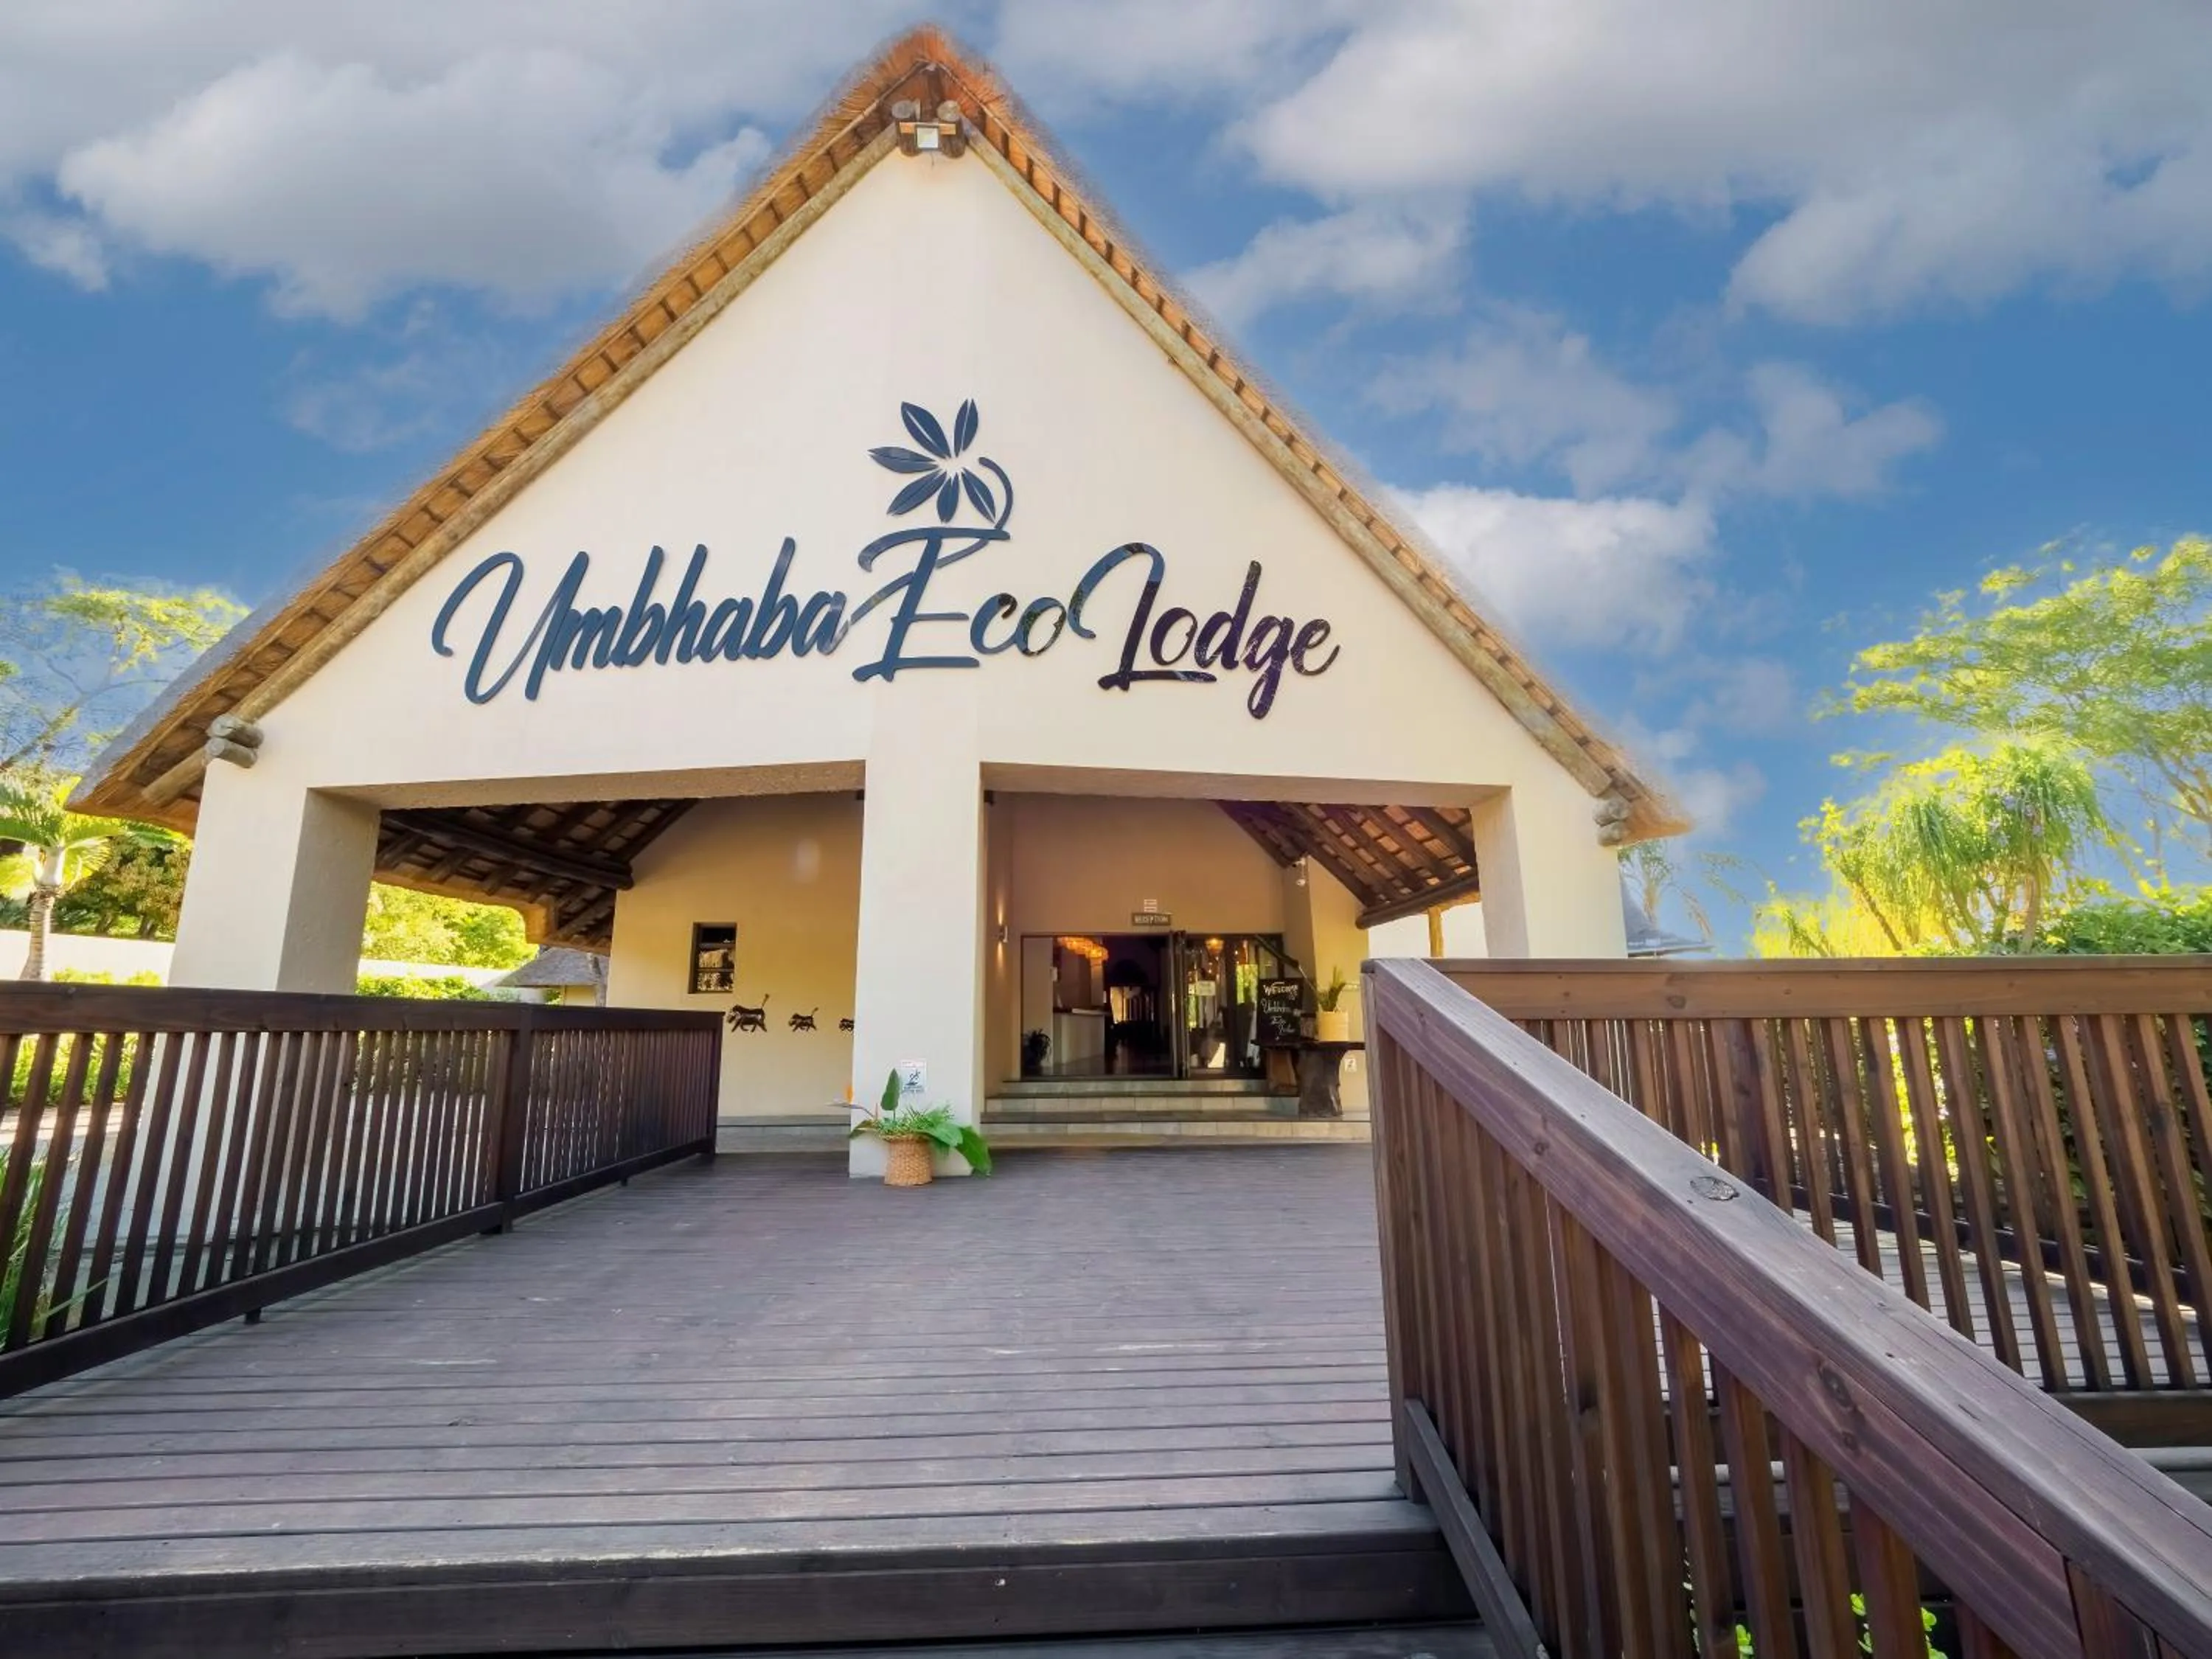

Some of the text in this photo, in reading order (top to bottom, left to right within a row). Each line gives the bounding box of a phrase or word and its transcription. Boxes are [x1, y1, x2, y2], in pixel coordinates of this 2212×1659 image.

[431, 526, 1341, 720] Umbhaba Eco Lodge
